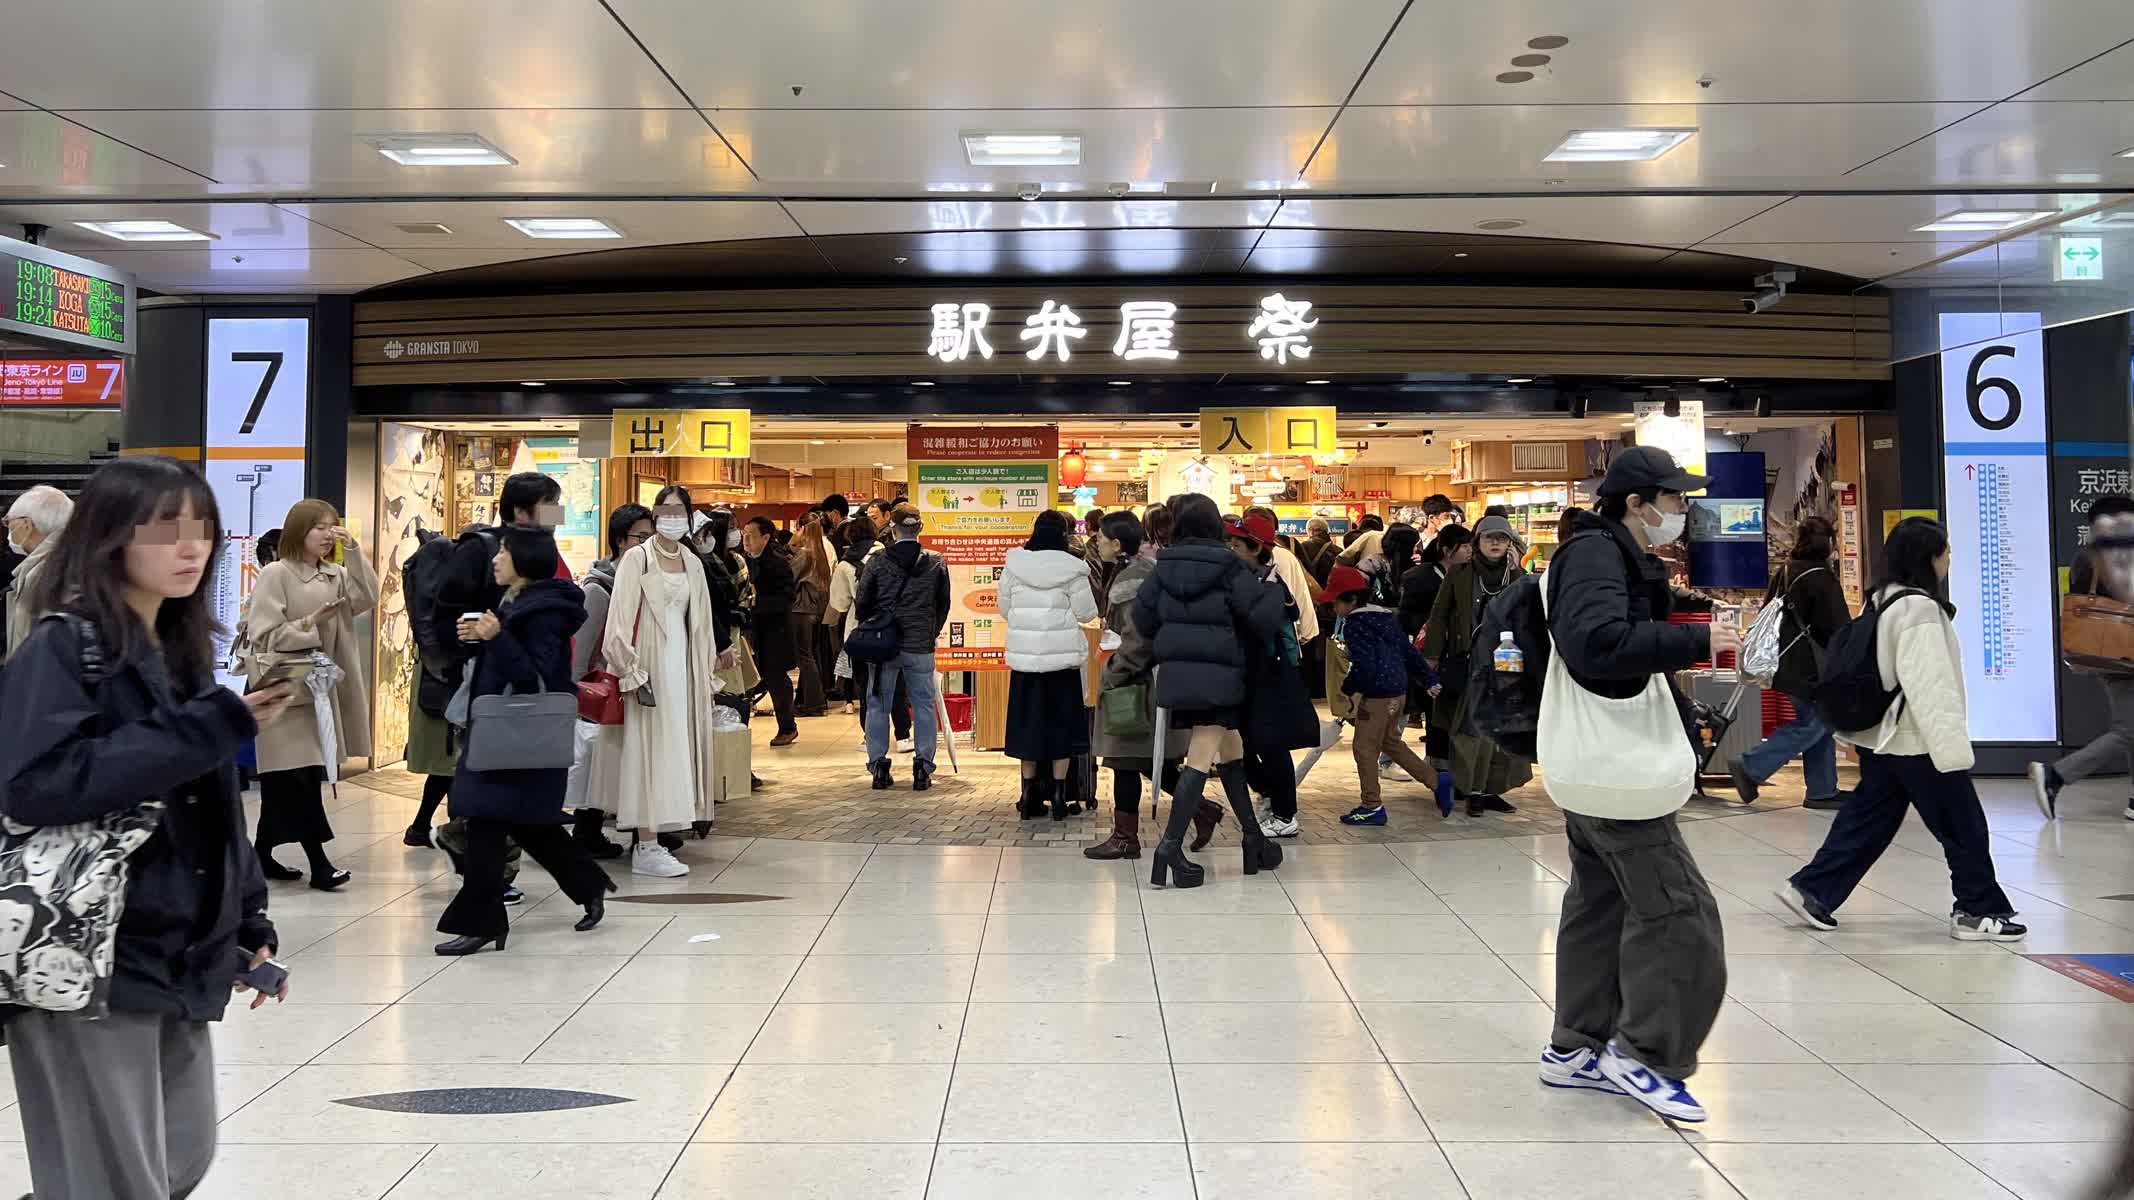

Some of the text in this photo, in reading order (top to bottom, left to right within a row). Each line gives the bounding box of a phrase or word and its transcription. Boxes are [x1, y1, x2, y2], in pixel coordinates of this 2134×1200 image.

[16, 258, 54, 286] 19:08
[53, 269, 89, 294] TAKASAKI
[16, 280, 53, 306] 19:14
[58, 290, 83, 313] KOGA
[16, 301, 53, 327] 19:24
[53, 309, 89, 333] KATSUTA
[927, 293, 1318, 364] 駅弁屋 祭
[407, 340, 479, 355] GRANSTA TOKYO
[0, 364, 63, 377] 東京ライン
[96, 364, 120, 400] 7
[232, 352, 284, 434] 7
[1966, 345, 2022, 431] 6
[630, 417, 732, 453] 出口
[923, 437, 1043, 449] 混雑緩和ご協力のお願い
[1217, 417, 1318, 451] 入口
[2078, 468, 2133, 494] 京浜東
